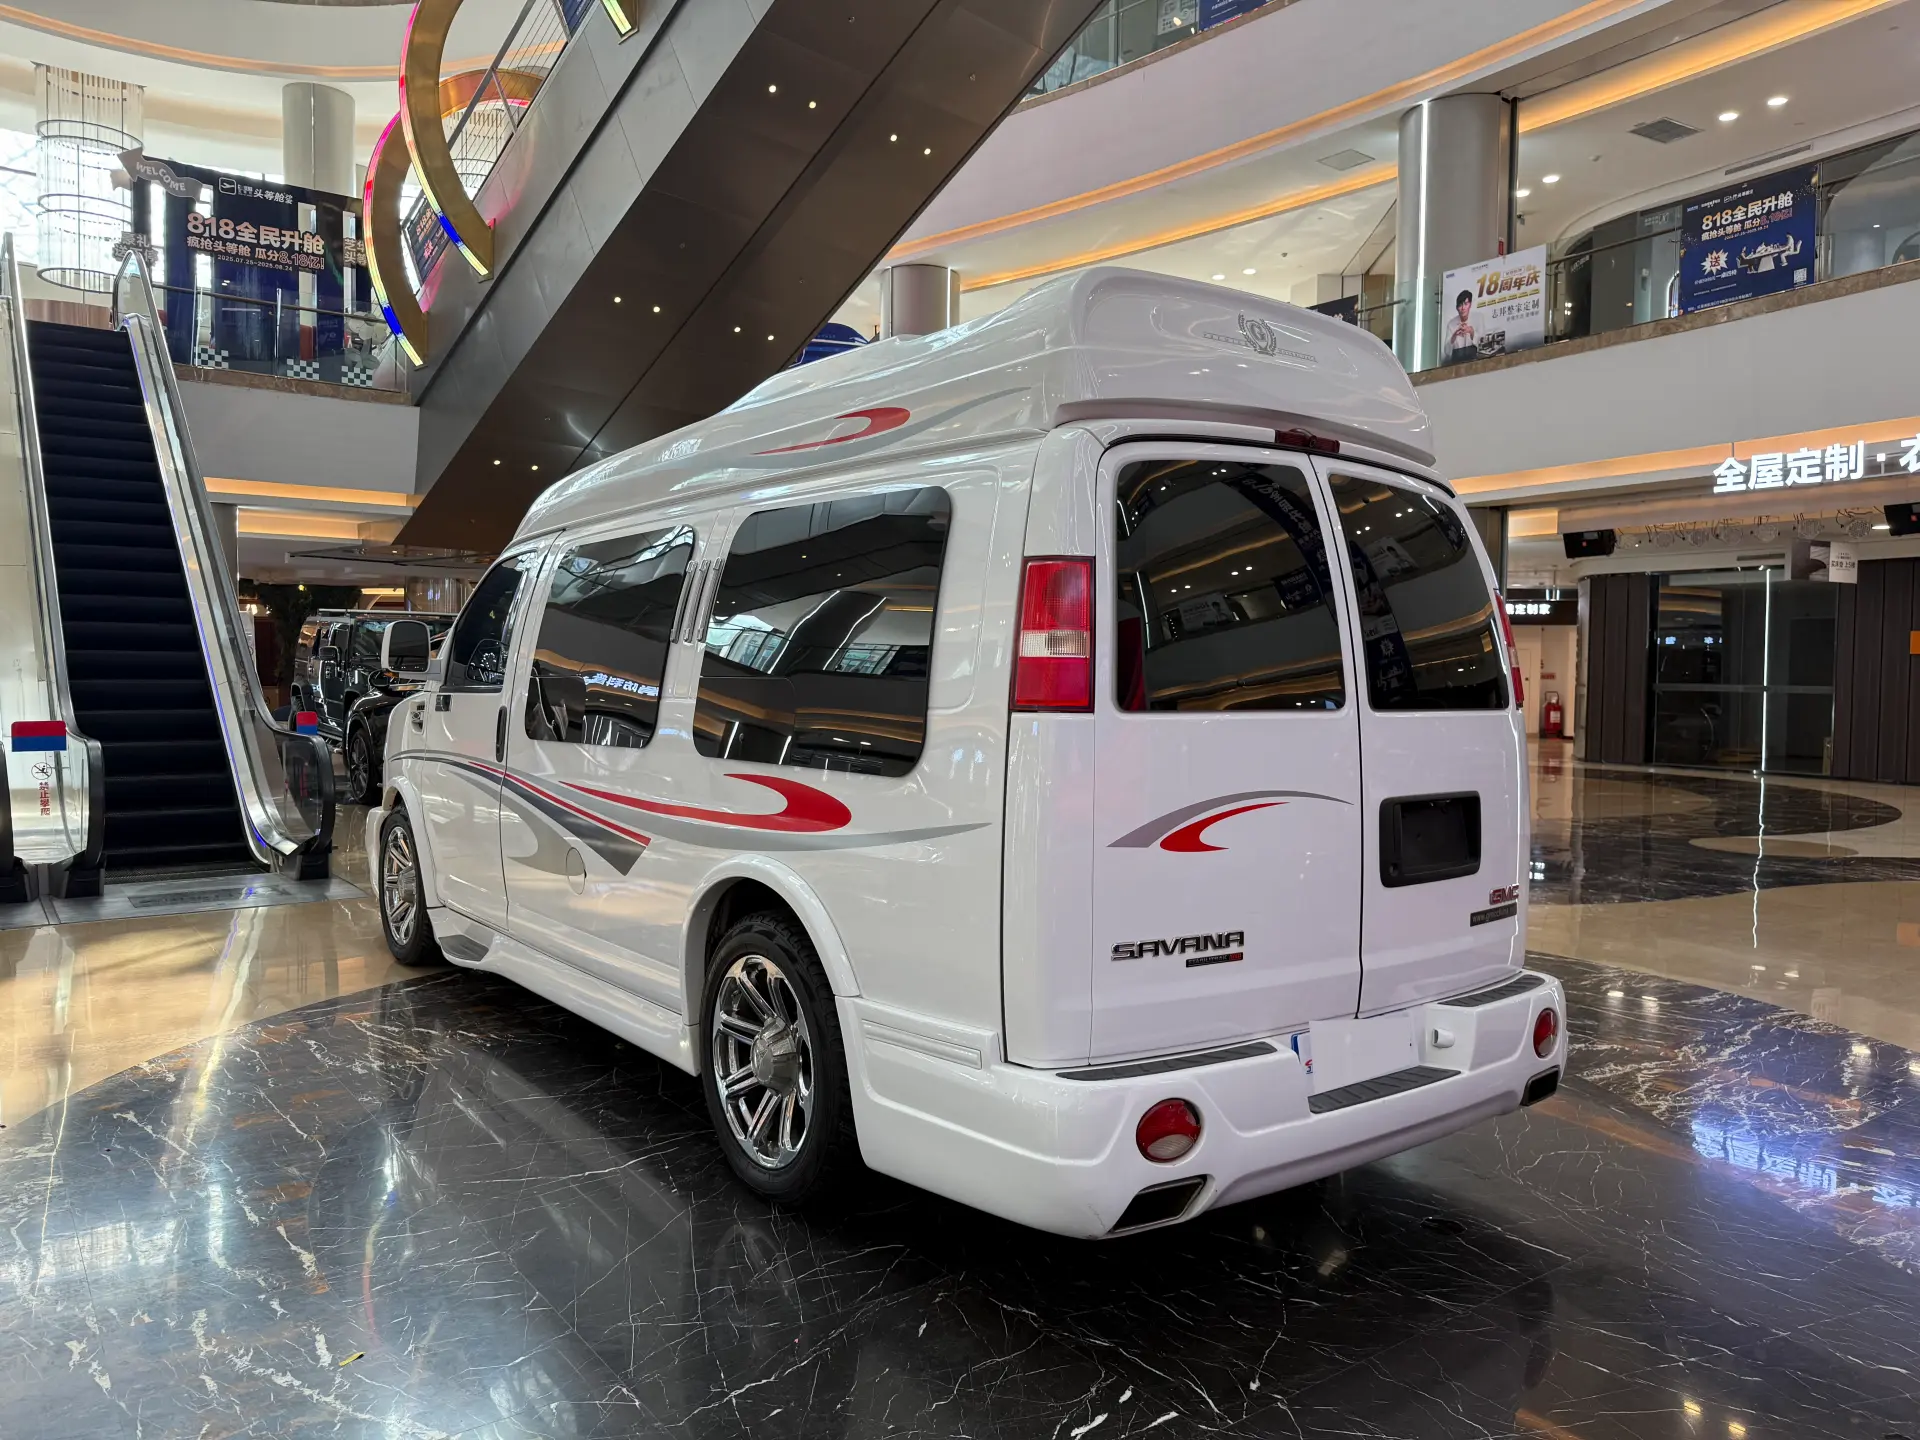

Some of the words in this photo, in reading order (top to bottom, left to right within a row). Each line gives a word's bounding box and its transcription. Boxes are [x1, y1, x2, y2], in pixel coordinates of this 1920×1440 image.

[135, 161, 186, 191] WELCOME
[1701, 190, 1793, 231] 818全民升舱
[187, 212, 325, 255] 818全民升舱
[187, 236, 251, 257] 疯抢头等舱
[1476, 270, 1541, 298] 18周年庆
[1489, 884, 1519, 905] GMC
[1111, 929, 1244, 961] SAVANA
